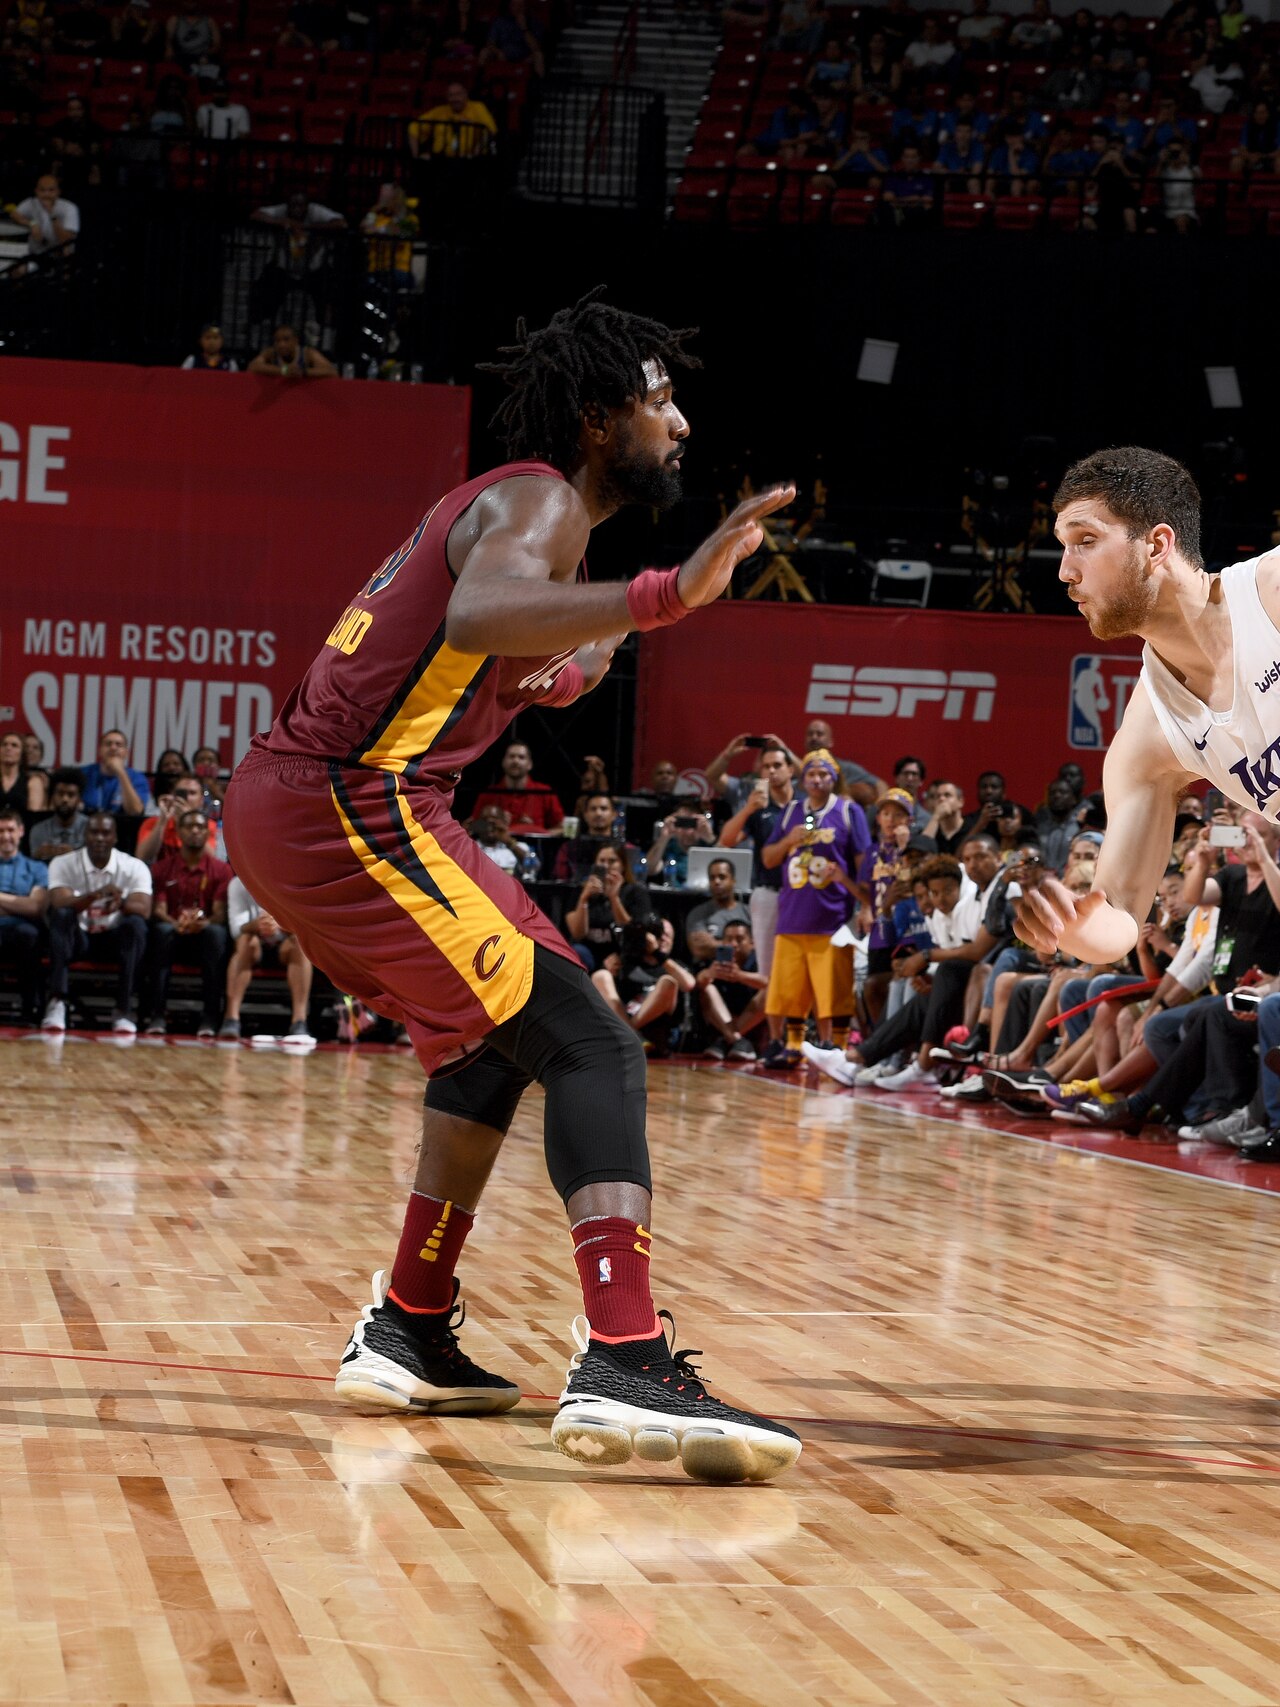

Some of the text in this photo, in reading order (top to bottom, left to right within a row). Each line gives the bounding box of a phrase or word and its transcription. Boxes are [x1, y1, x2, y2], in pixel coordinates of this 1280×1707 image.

[24, 618, 277, 668] MGM RESORTS
[805, 663, 998, 722] ESPN
[1111, 676, 1140, 731] T
